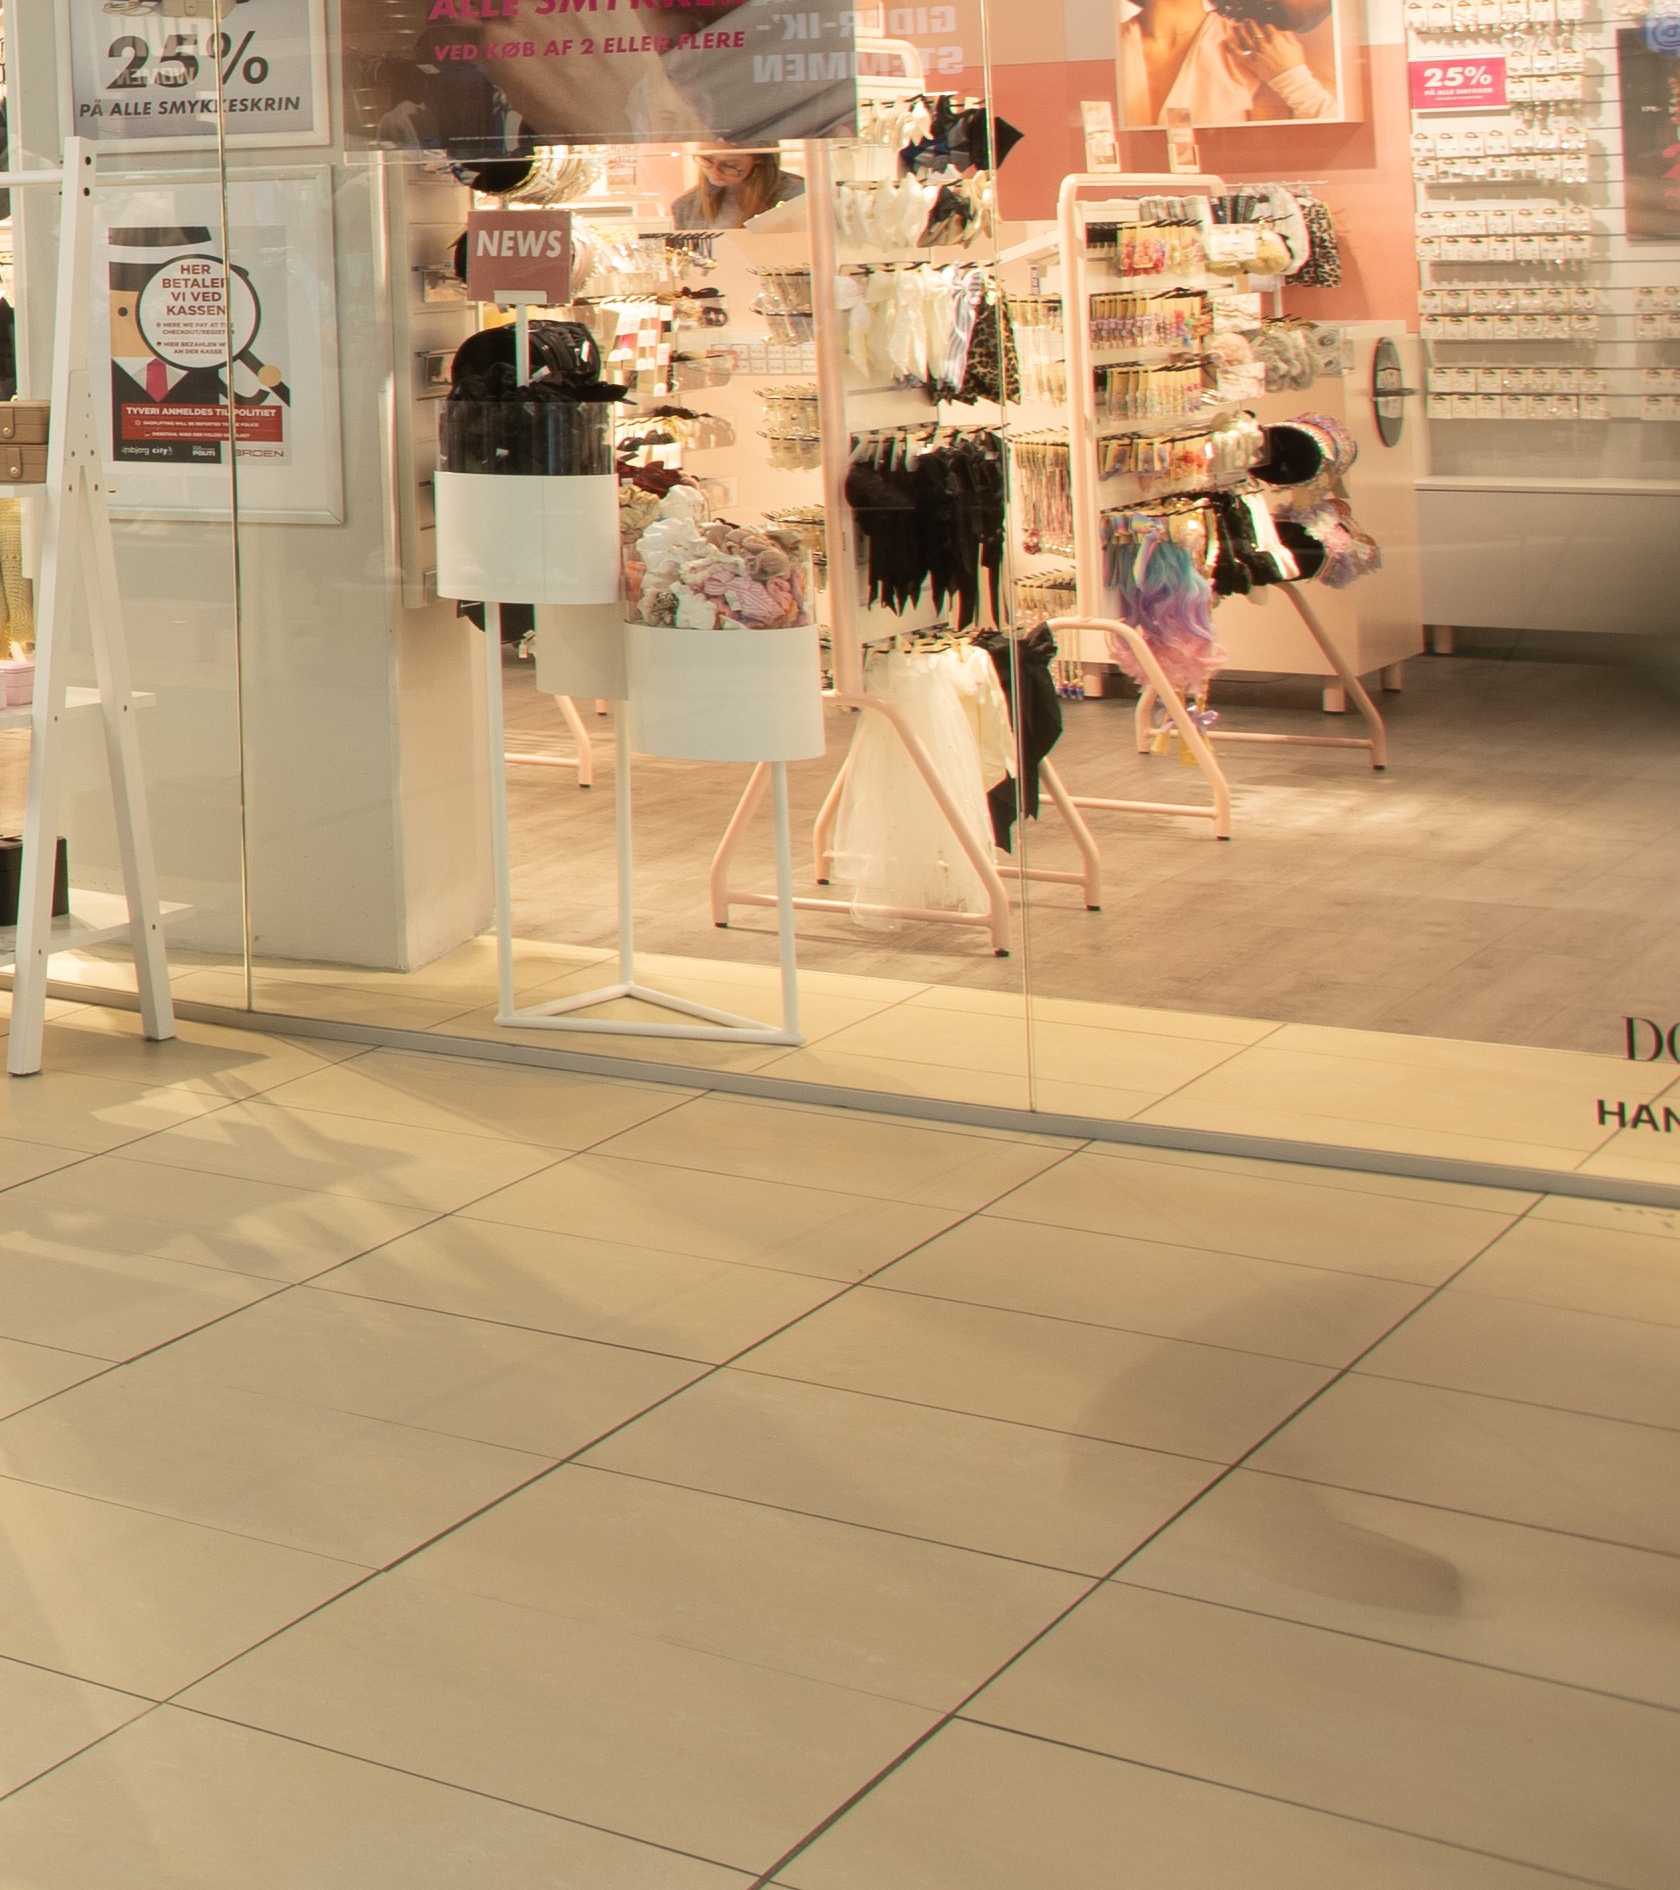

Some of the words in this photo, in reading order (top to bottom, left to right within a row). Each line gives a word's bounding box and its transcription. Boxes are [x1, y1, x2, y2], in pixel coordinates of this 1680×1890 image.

[435, 45, 478, 61] VED
[486, 42, 536, 60] KØB
[545, 39, 573, 56] AF
[580, 38, 594, 55] 2
[604, 34, 669, 54] ELLER
[678, 31, 745, 50] FLERE
[106, 30, 269, 89] 25%
[1424, 66, 1492, 87] 25%
[80, 99, 104, 117] PÅ
[109, 102, 152, 116] ALLE
[476, 228, 562, 259] NEWS
[180, 264, 211, 275] HER
[171, 292, 186, 302] VI
[191, 292, 222, 302] VED
[166, 305, 226, 316] KASSEN
[126, 407, 160, 415] TYVERI
[161, 407, 214, 416] ANMELDES
